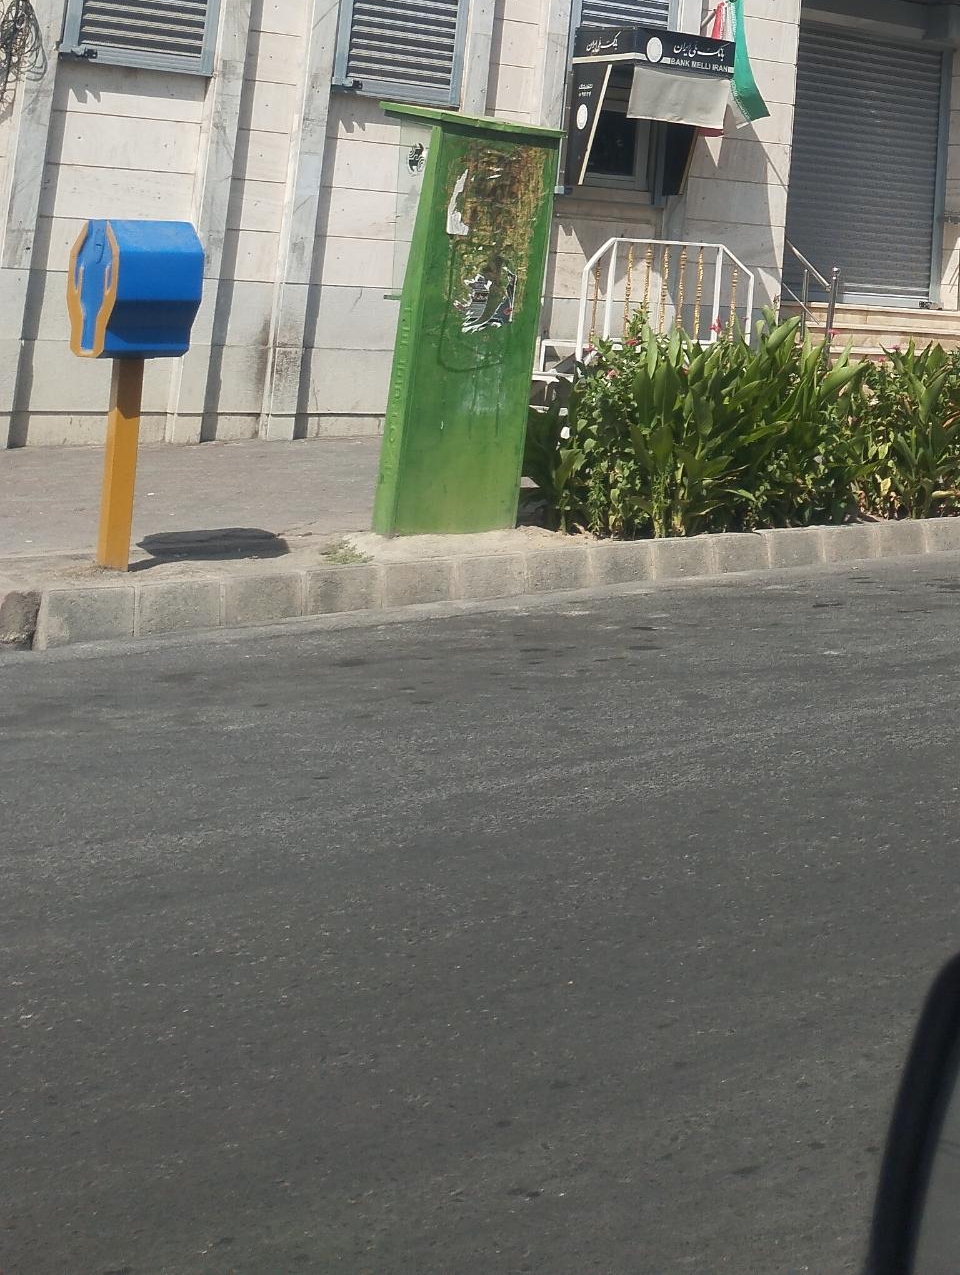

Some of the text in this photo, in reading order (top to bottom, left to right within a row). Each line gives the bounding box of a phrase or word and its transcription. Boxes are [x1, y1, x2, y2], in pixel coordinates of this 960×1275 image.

[601, 31, 621, 51] بانک
[673, 40, 730, 62] بانک ملی ایران
[670, 57, 729, 72] BANK MELLI IRAN
